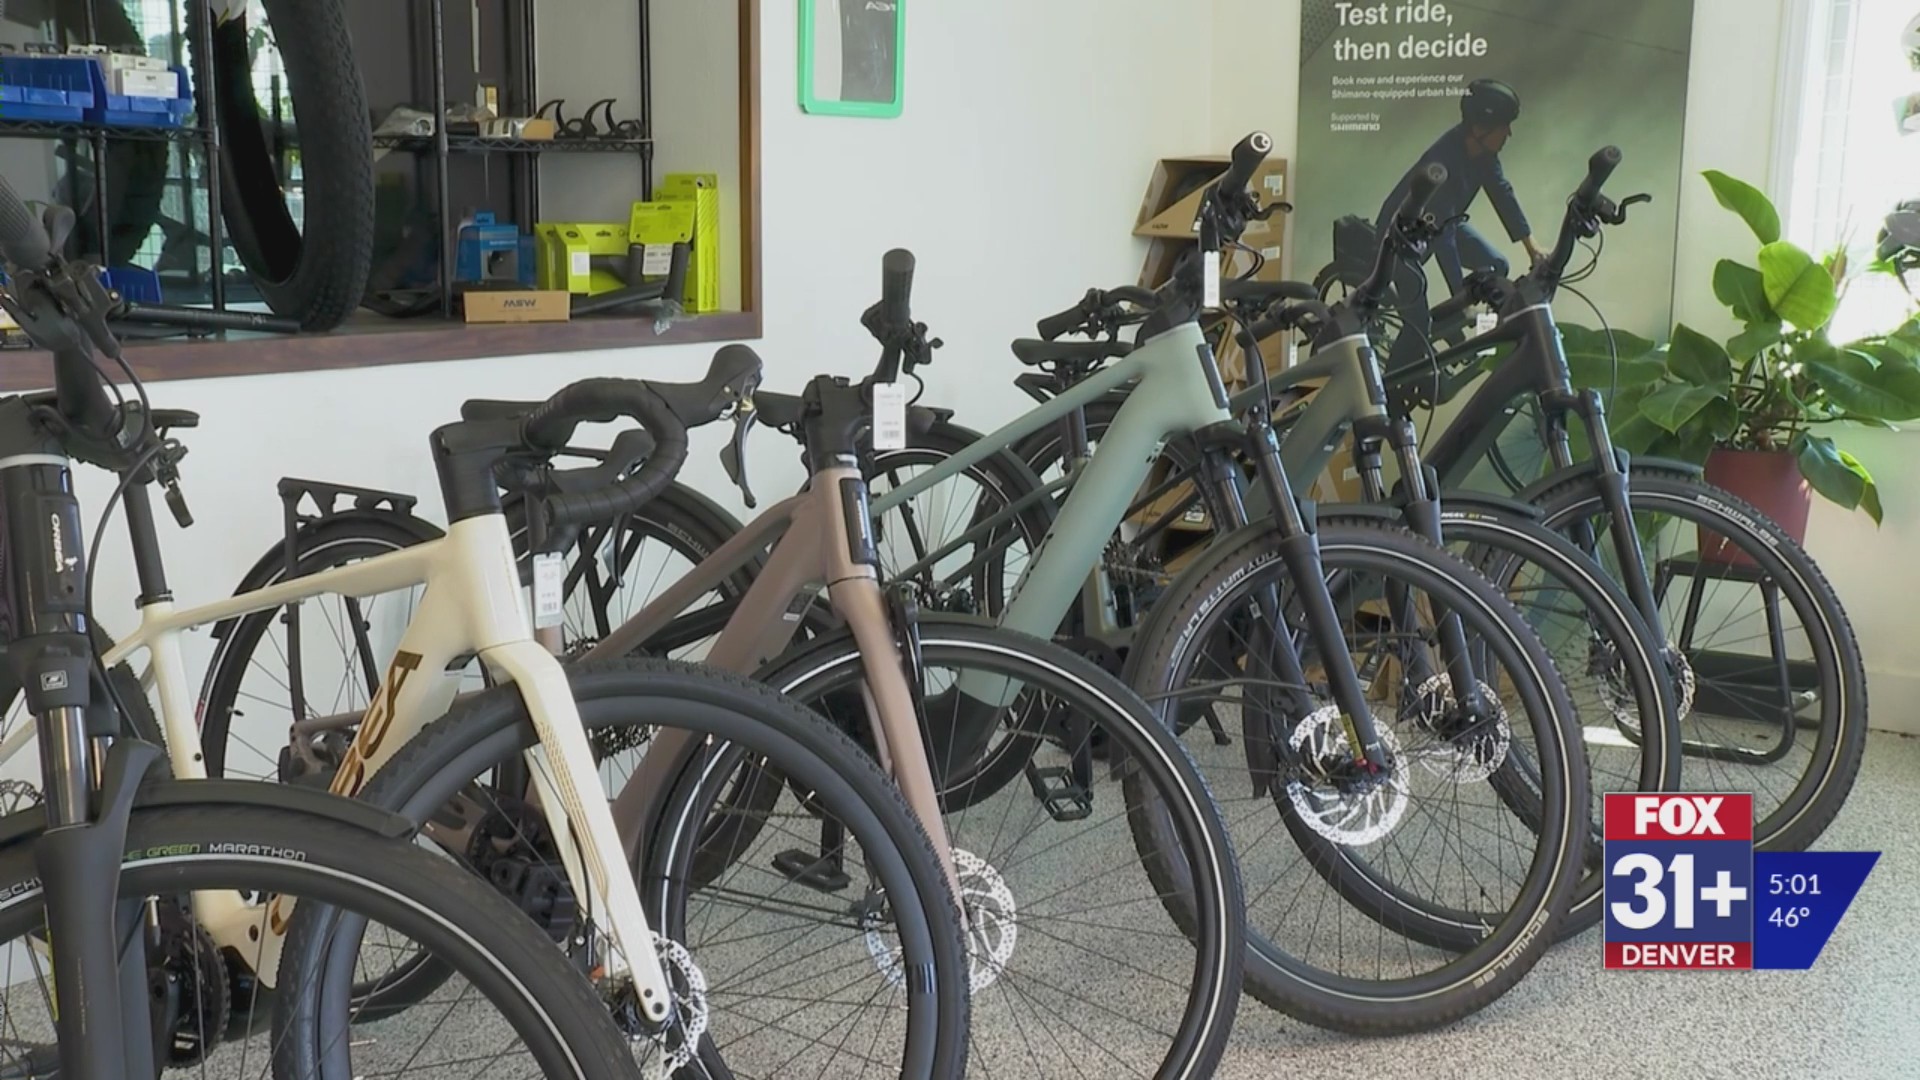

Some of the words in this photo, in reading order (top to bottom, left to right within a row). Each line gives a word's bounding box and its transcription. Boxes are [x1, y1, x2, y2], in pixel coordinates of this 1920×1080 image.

[1334, 2, 1389, 26] Test
[1395, 0, 1453, 27] ride,
[1333, 37, 1390, 61] then
[1398, 32, 1488, 60] decide
[1332, 76, 1354, 86] Book
[1356, 77, 1375, 85] now
[1376, 75, 1394, 85] and
[1395, 73, 1446, 85] experience
[1447, 74, 1463, 83] our
[1331, 87, 1415, 100] Shimano-equipped
[1417, 87, 1444, 97] urban
[1445, 86, 1473, 97] bikes.
[1330, 122, 1380, 132] SHIMANO
[1331, 112, 1370, 122] Supported
[1371, 111, 1380, 121] by
[51, 512, 64, 573] ORBEA
[209, 842, 306, 863] MARATHON
[1473, 908, 1550, 990] SCHWALBE
